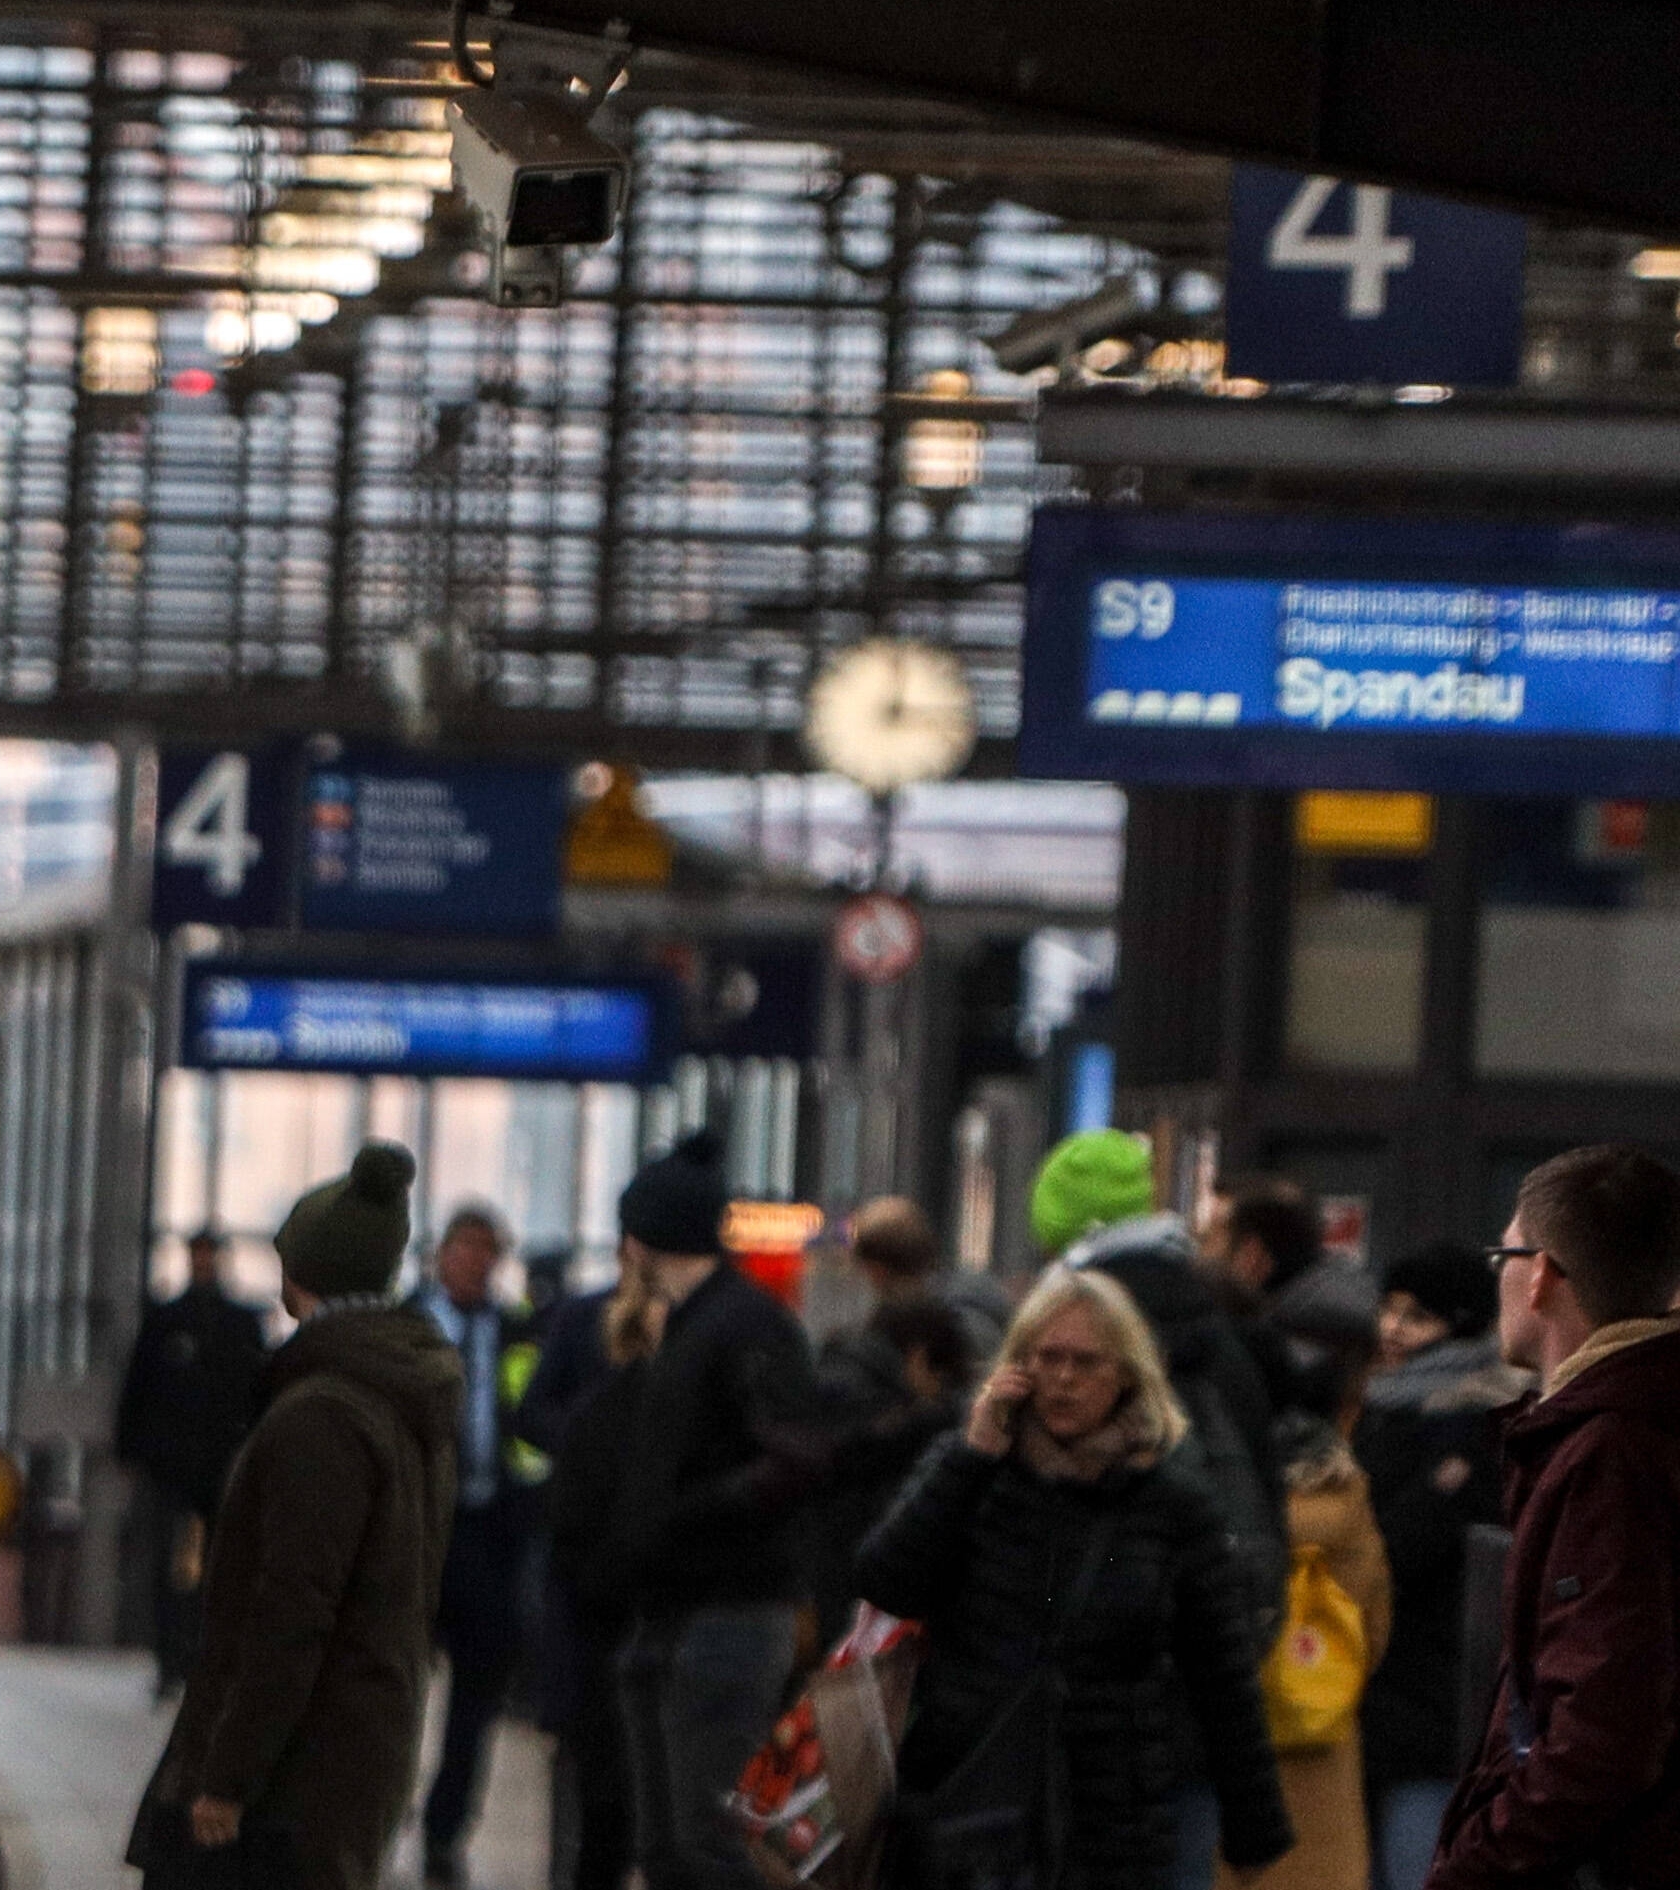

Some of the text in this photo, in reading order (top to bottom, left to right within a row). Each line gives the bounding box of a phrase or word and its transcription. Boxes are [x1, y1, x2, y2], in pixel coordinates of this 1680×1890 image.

[1267, 174, 1415, 320] 4
[1091, 579, 1176, 640] S9
[1275, 656, 1527, 730] Spandau
[165, 750, 262, 896] 4
